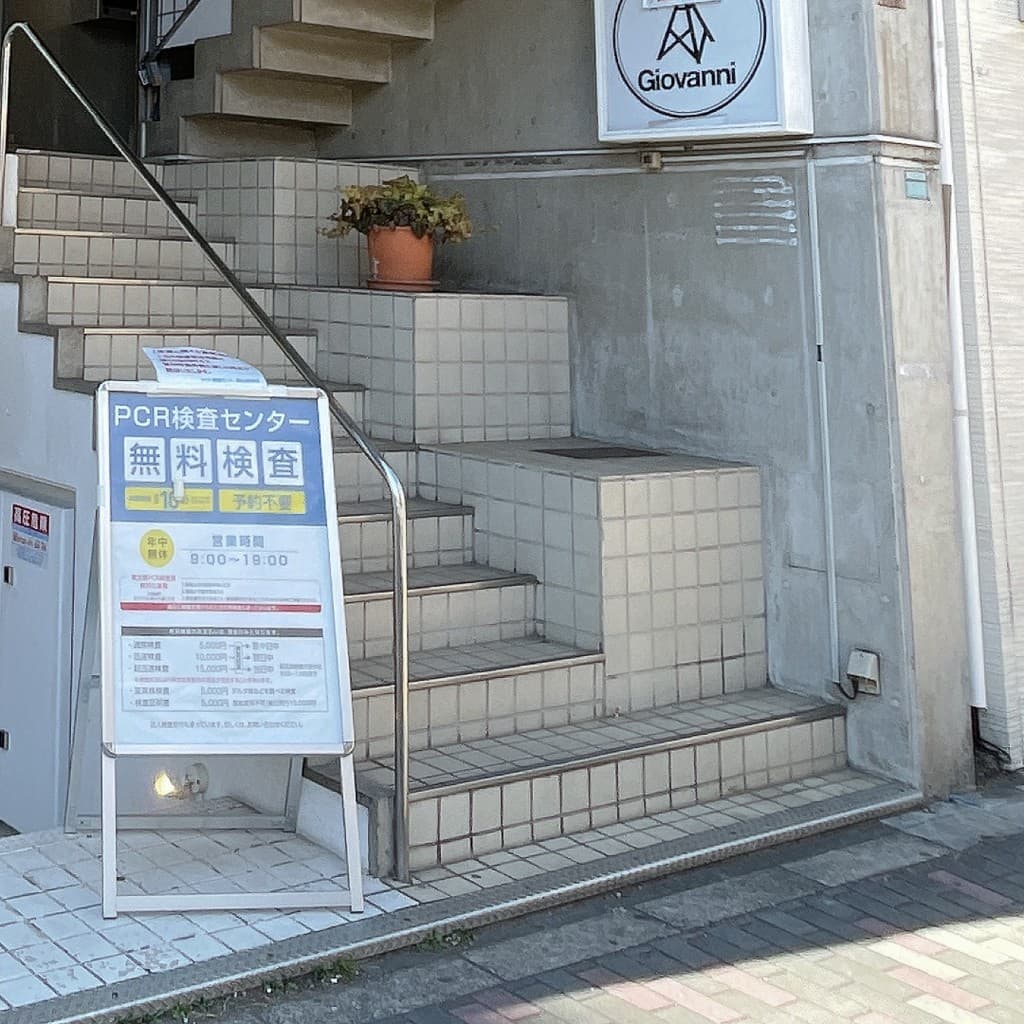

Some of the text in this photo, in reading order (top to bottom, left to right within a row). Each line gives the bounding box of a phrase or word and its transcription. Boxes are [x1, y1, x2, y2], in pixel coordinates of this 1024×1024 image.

[638, 61, 737, 92] Giovanni
[113, 404, 310, 433] PCR検査センター
[128, 442, 299, 480] 無料検査
[232, 494, 292, 511] 予約不要
